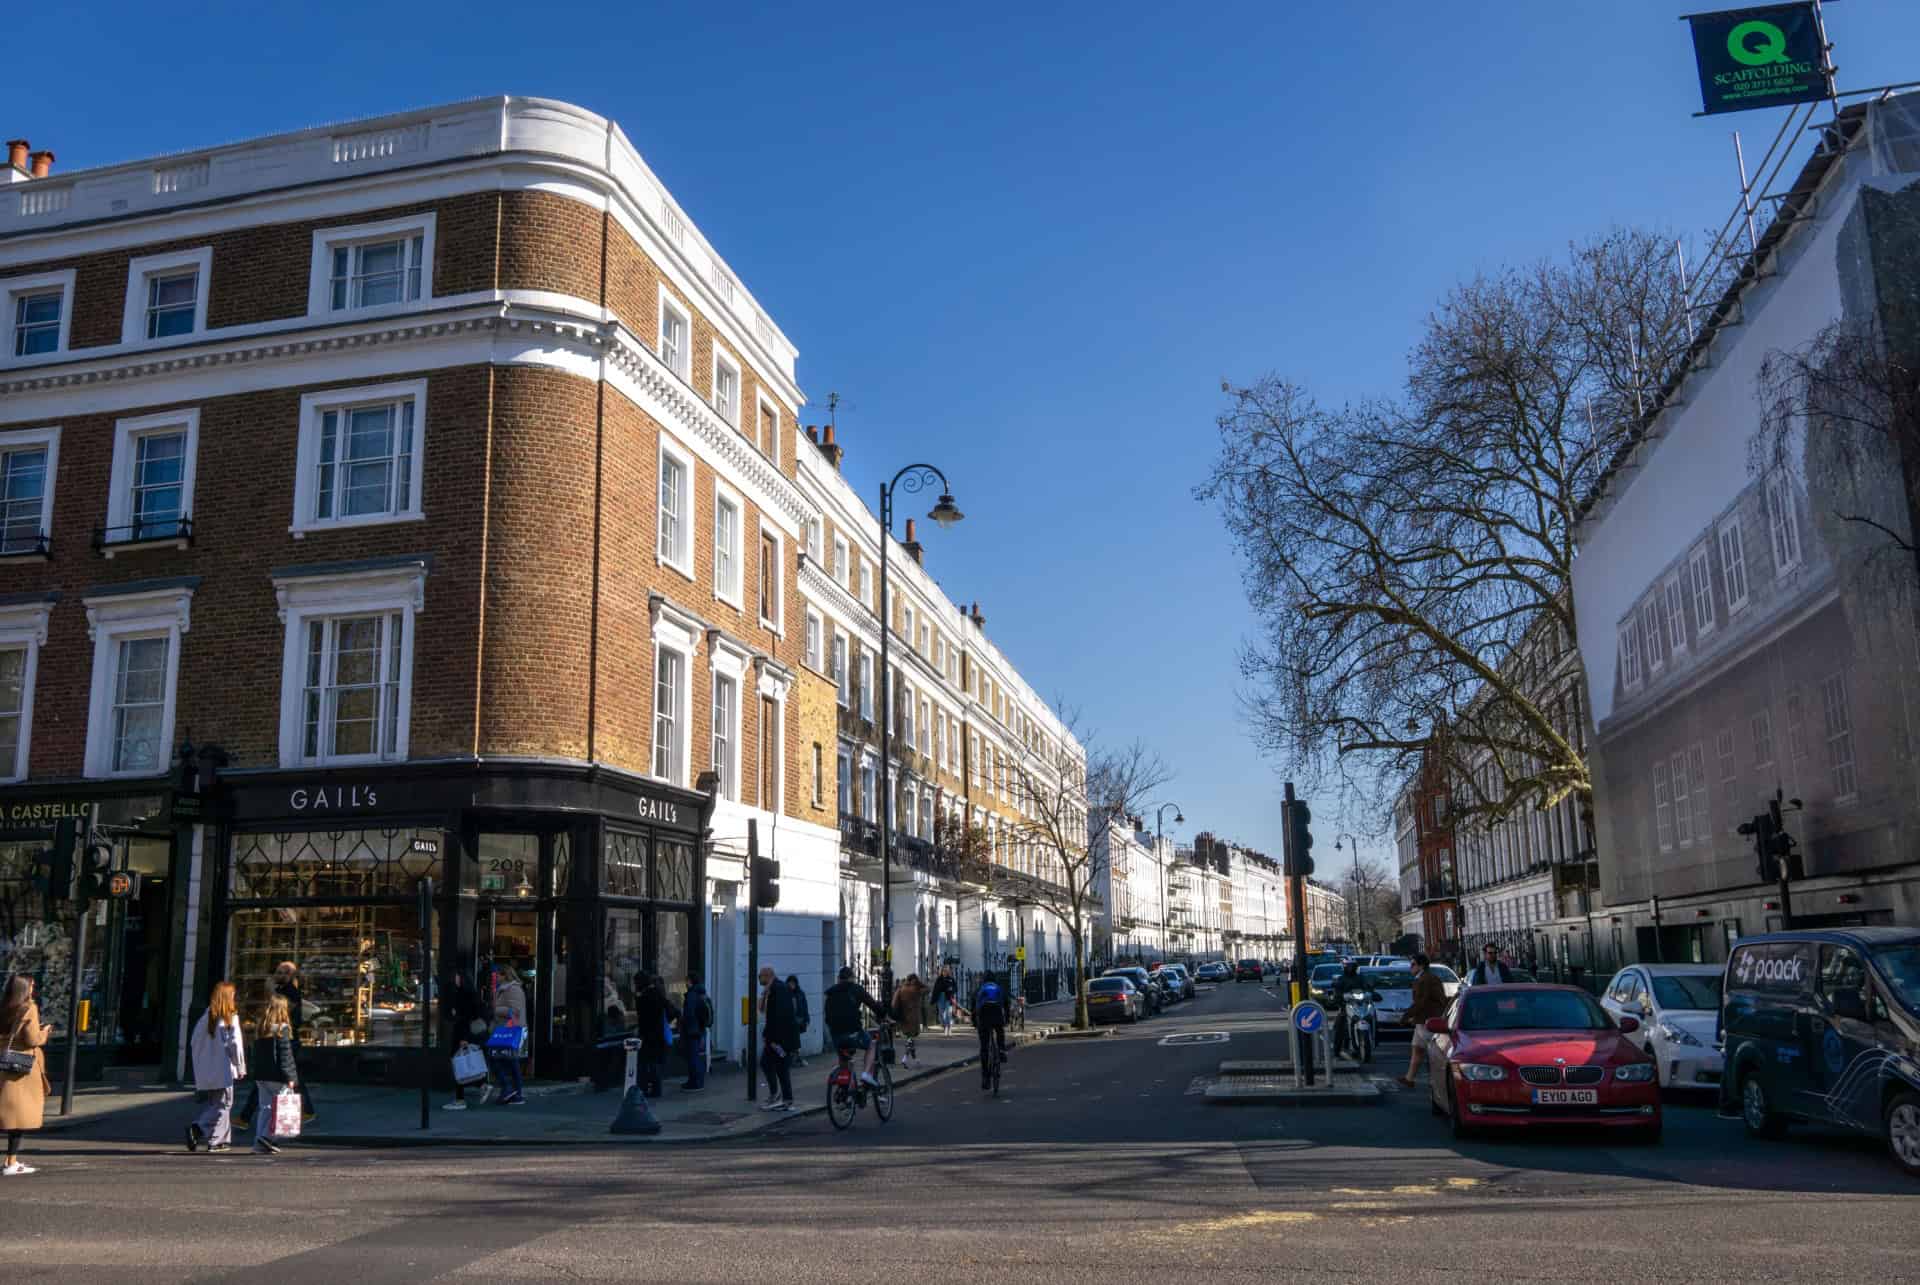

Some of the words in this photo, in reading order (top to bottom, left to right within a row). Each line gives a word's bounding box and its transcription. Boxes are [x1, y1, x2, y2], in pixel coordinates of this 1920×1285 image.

[1727, 20, 1791, 65] Q
[290, 785, 377, 809] GAIL's
[638, 796, 677, 824] GAIL's
[489, 858, 524, 873] 209
[1754, 954, 1801, 985] paack
